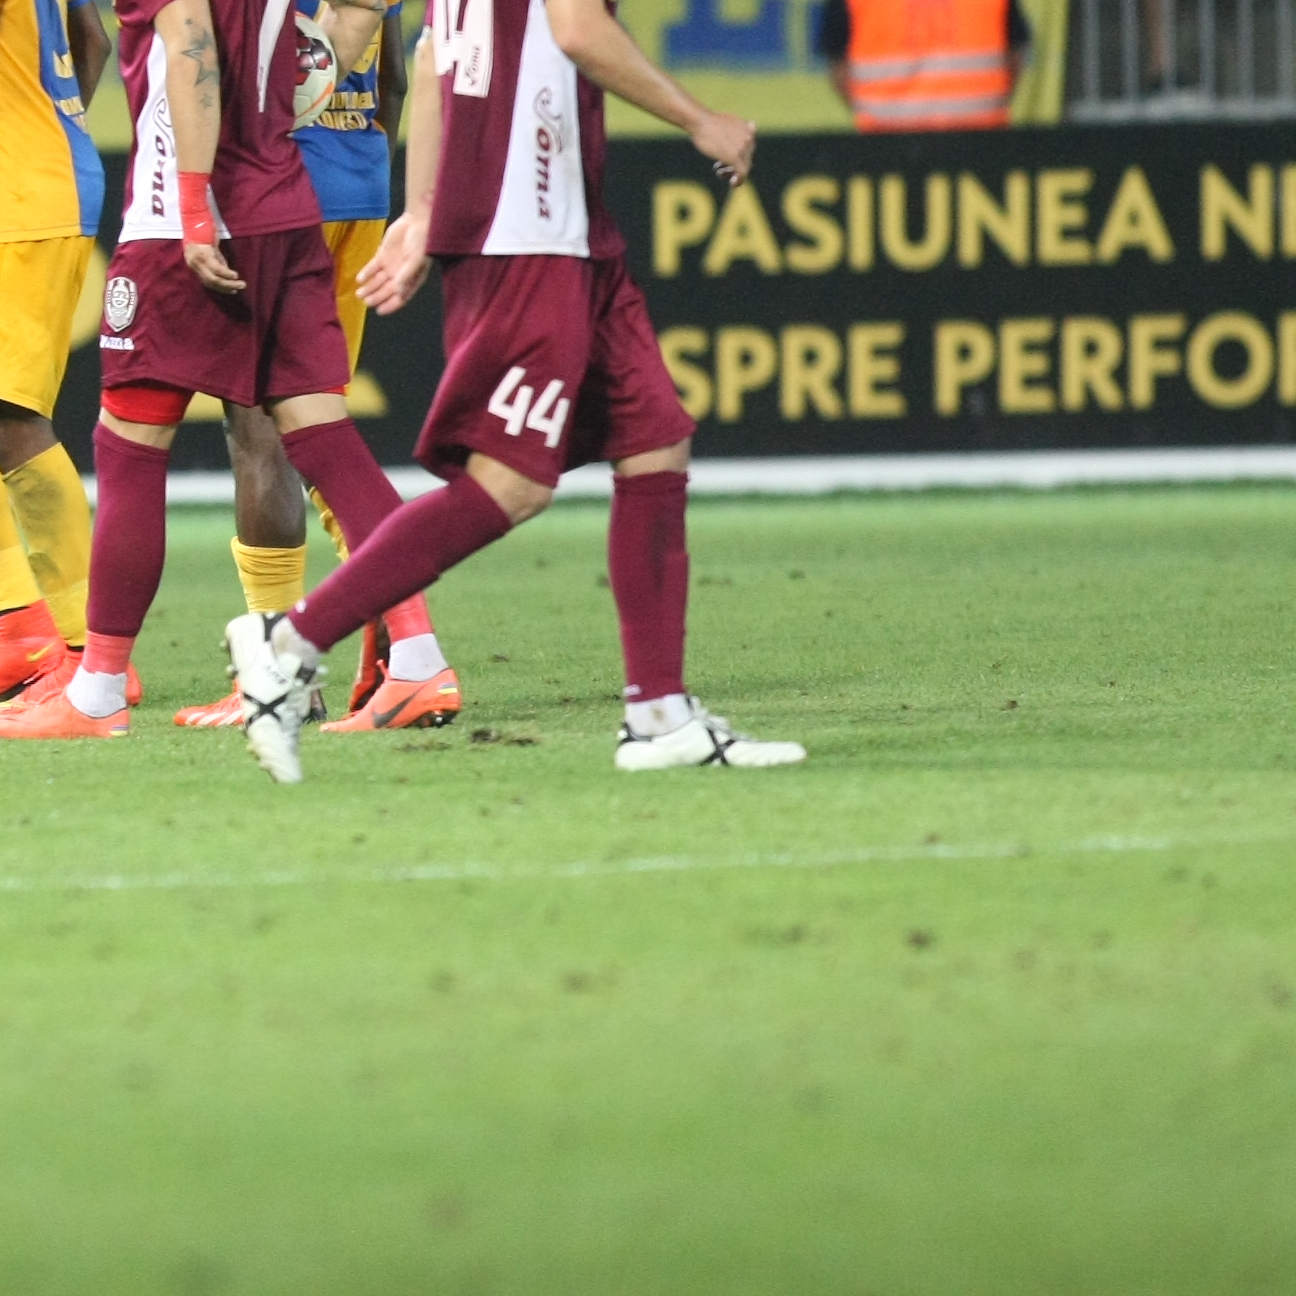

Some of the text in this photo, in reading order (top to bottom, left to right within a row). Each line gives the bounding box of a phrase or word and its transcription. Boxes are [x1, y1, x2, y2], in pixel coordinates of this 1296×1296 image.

[651, 162, 1296, 278] PASIUNEA N
[487, 365, 571, 450] 44
